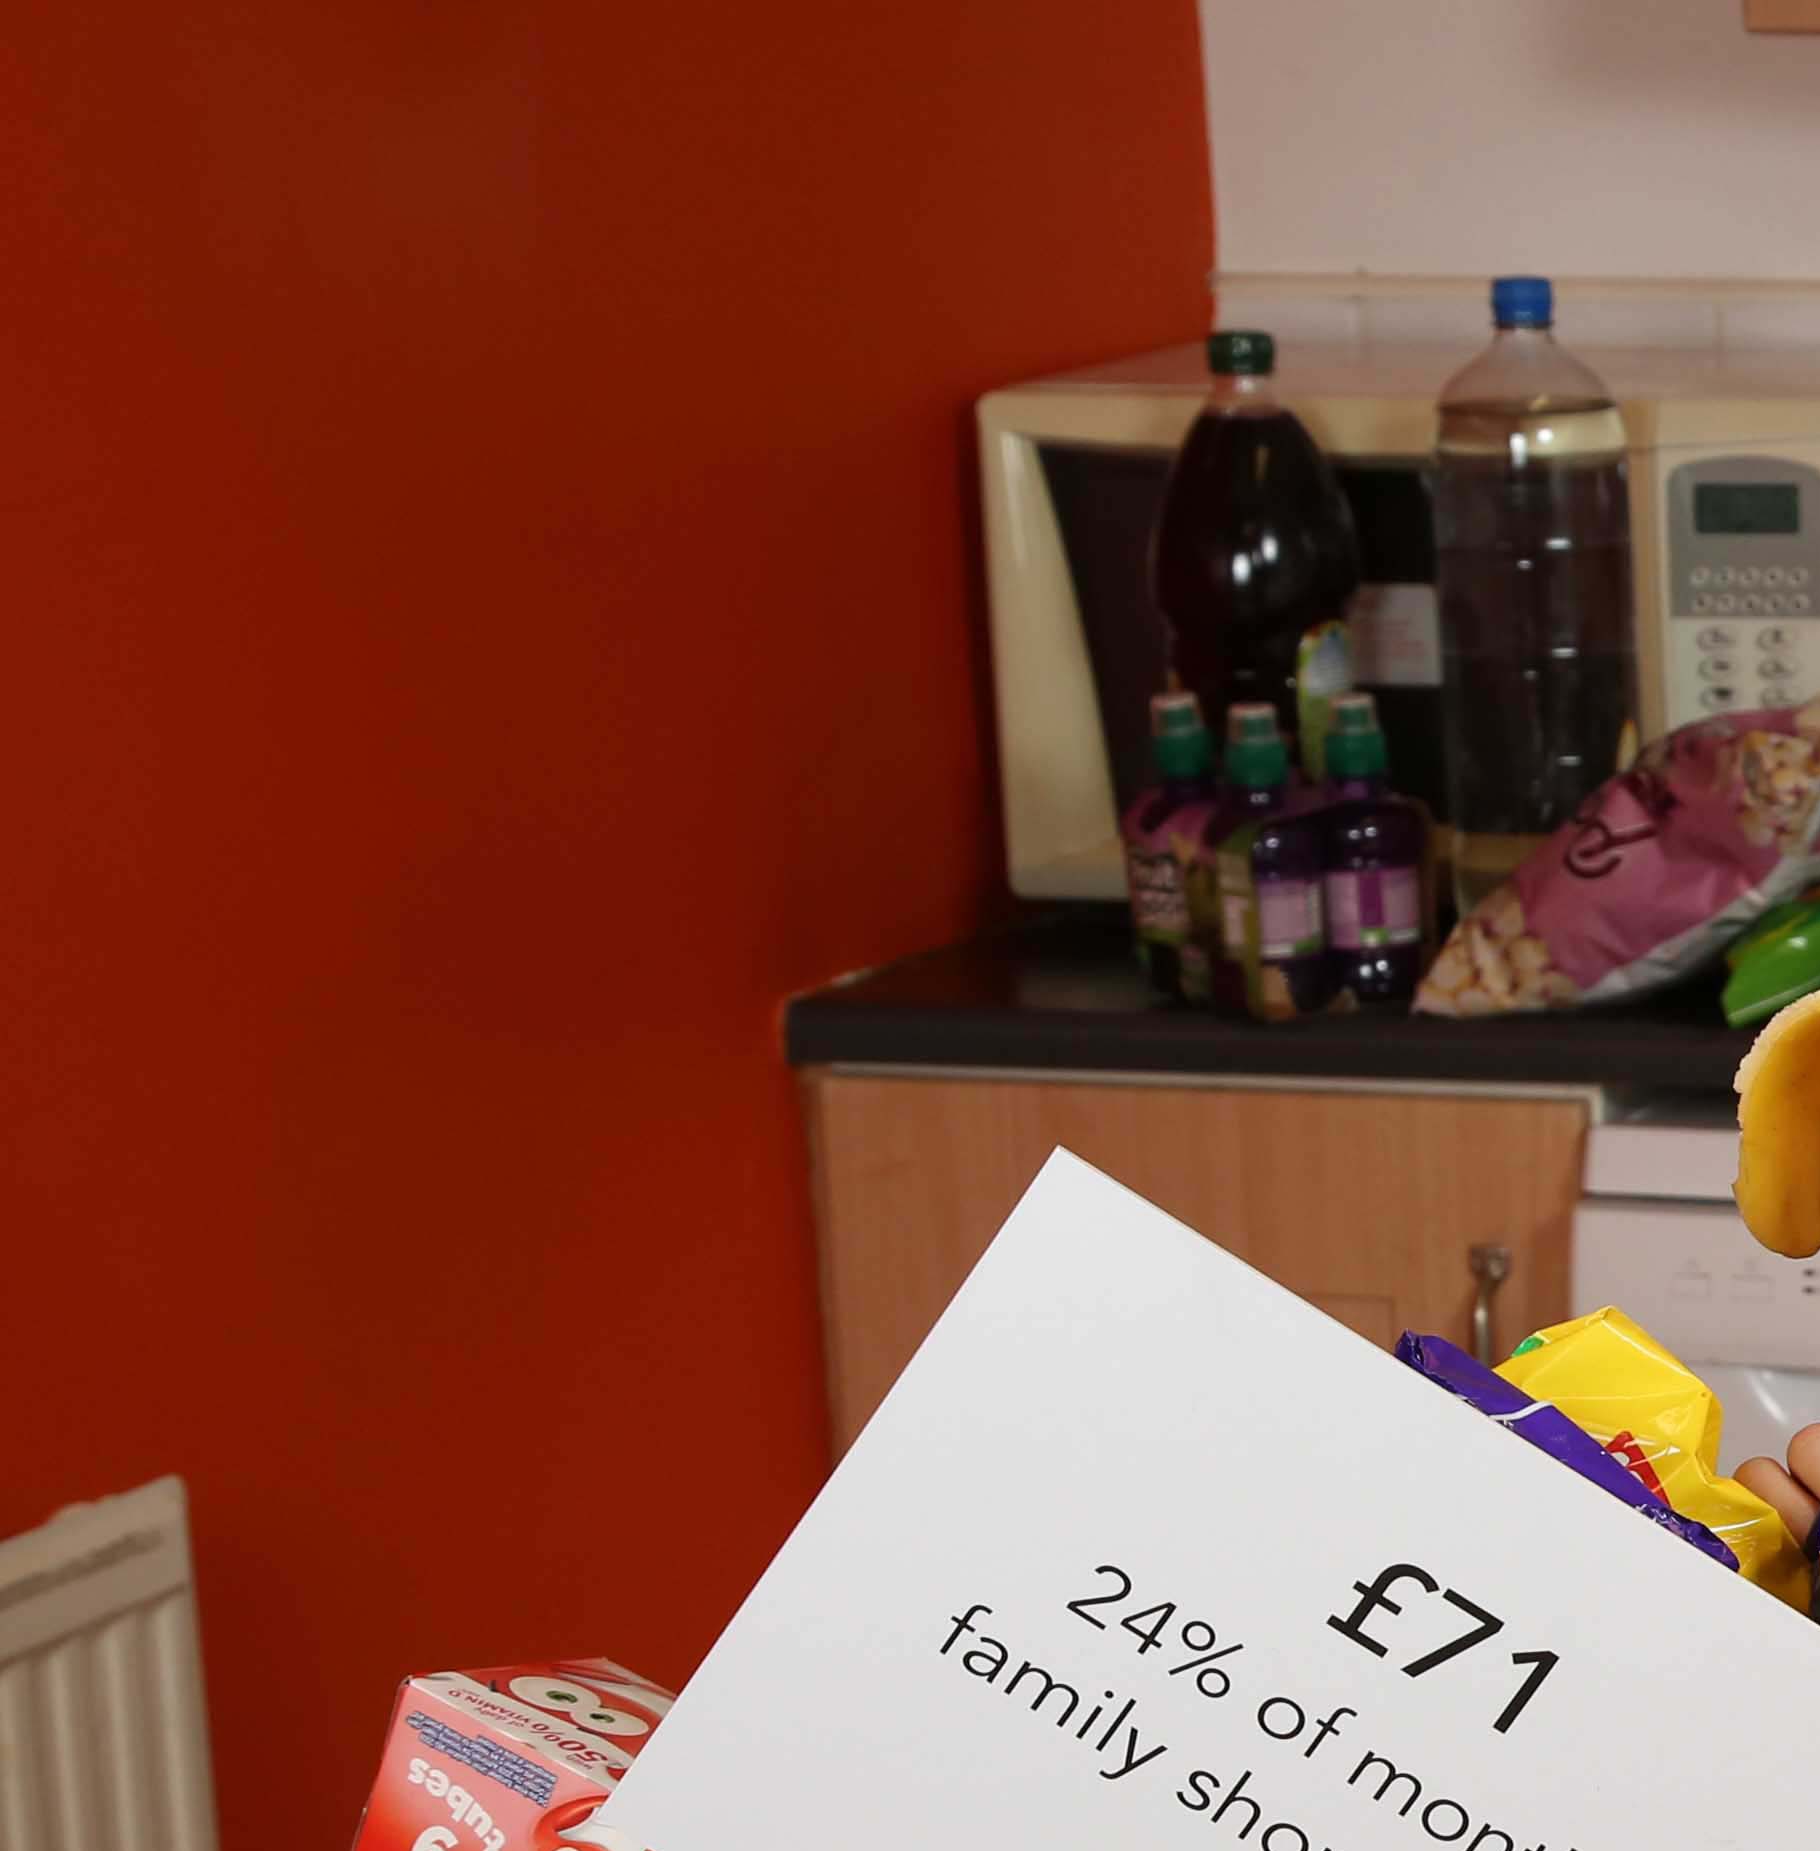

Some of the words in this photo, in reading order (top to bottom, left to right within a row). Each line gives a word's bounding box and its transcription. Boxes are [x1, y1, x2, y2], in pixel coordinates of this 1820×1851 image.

[938, 1604, 1168, 1782] family
[1065, 1564, 1245, 1699] 24%
[1256, 1695, 1358, 1760] of
[1326, 1562, 1561, 1735] £71
[530, 1720, 610, 1765] 50%
